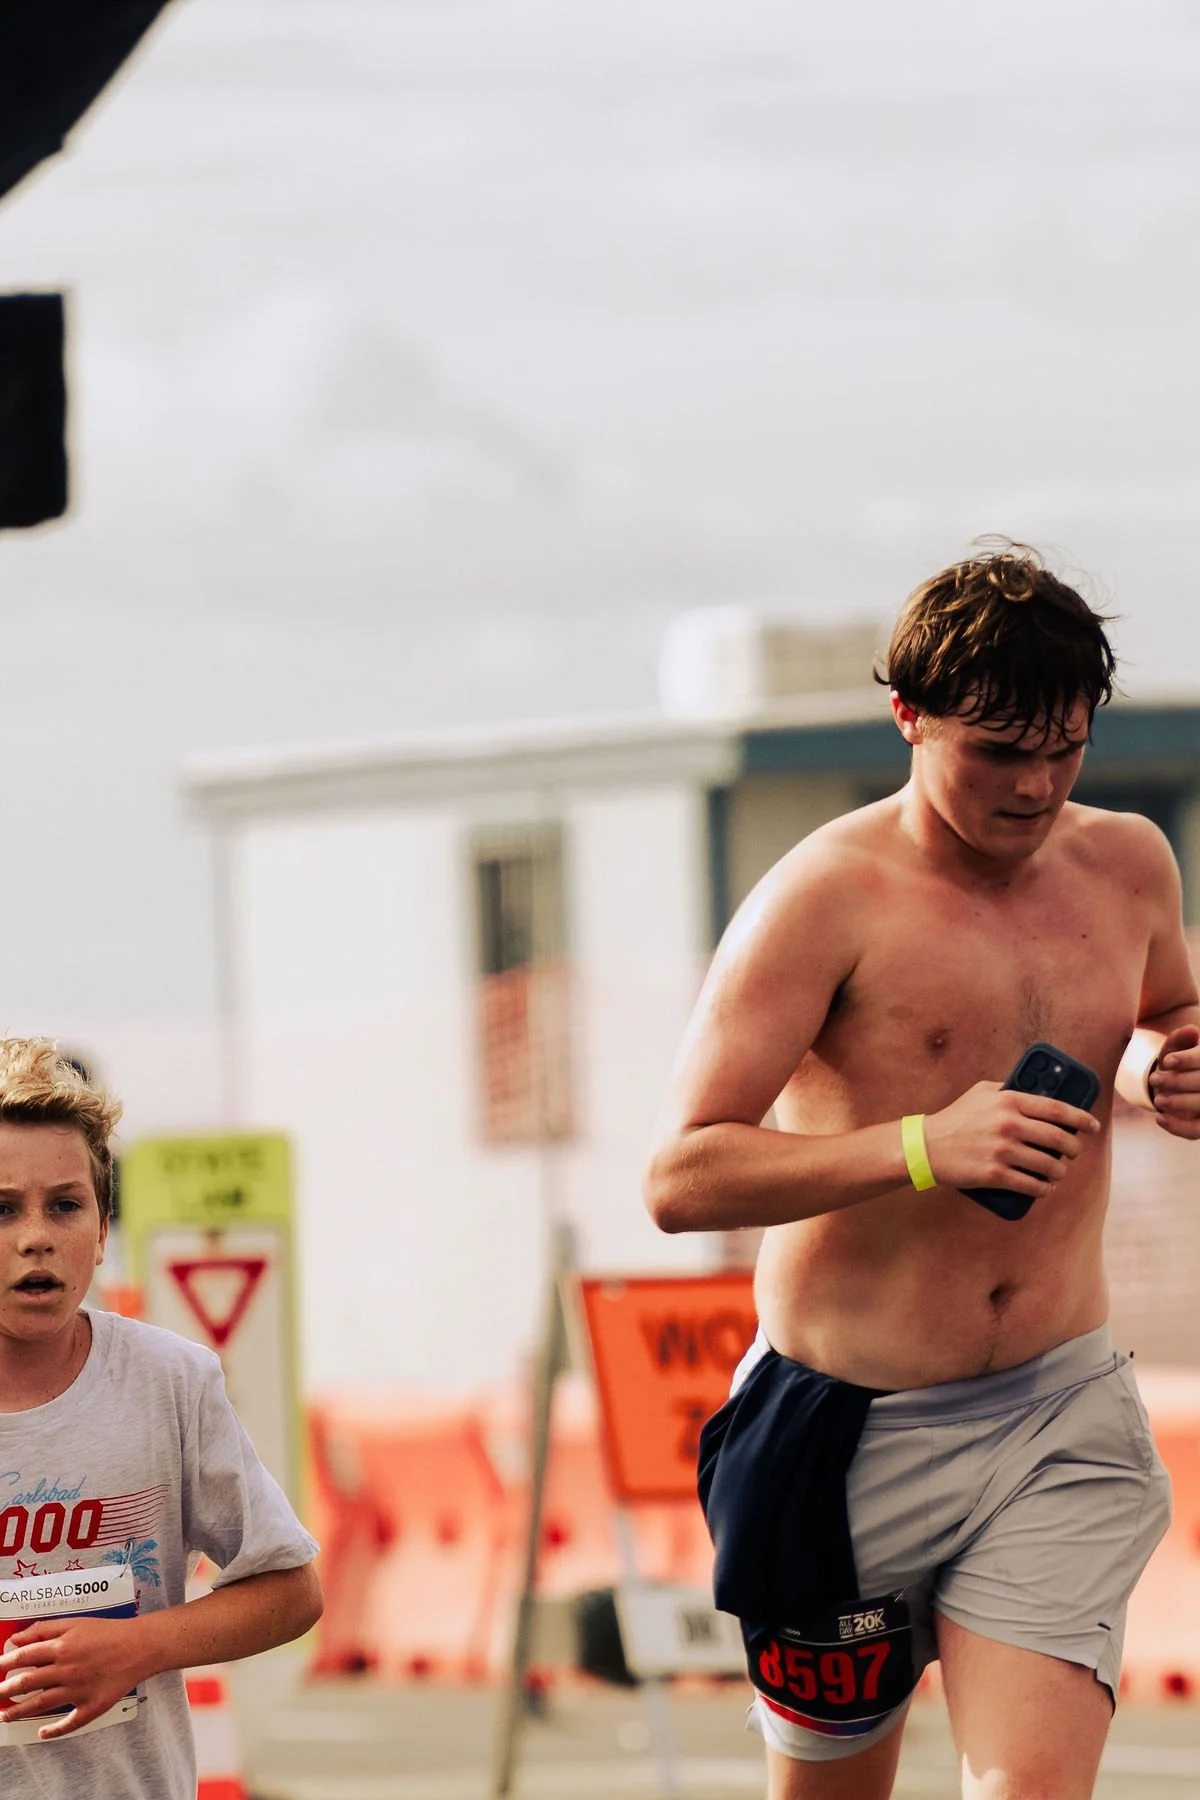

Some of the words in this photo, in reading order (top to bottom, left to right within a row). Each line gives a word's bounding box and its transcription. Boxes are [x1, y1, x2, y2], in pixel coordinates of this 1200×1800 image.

[640, 1311, 758, 1371] WO
[0, 1580, 109, 1603] CARLSBAD5000
[33, 1600, 56, 1608] YEARS
[853, 1611, 886, 1632] 20K
[759, 1640, 891, 1705] 8597
